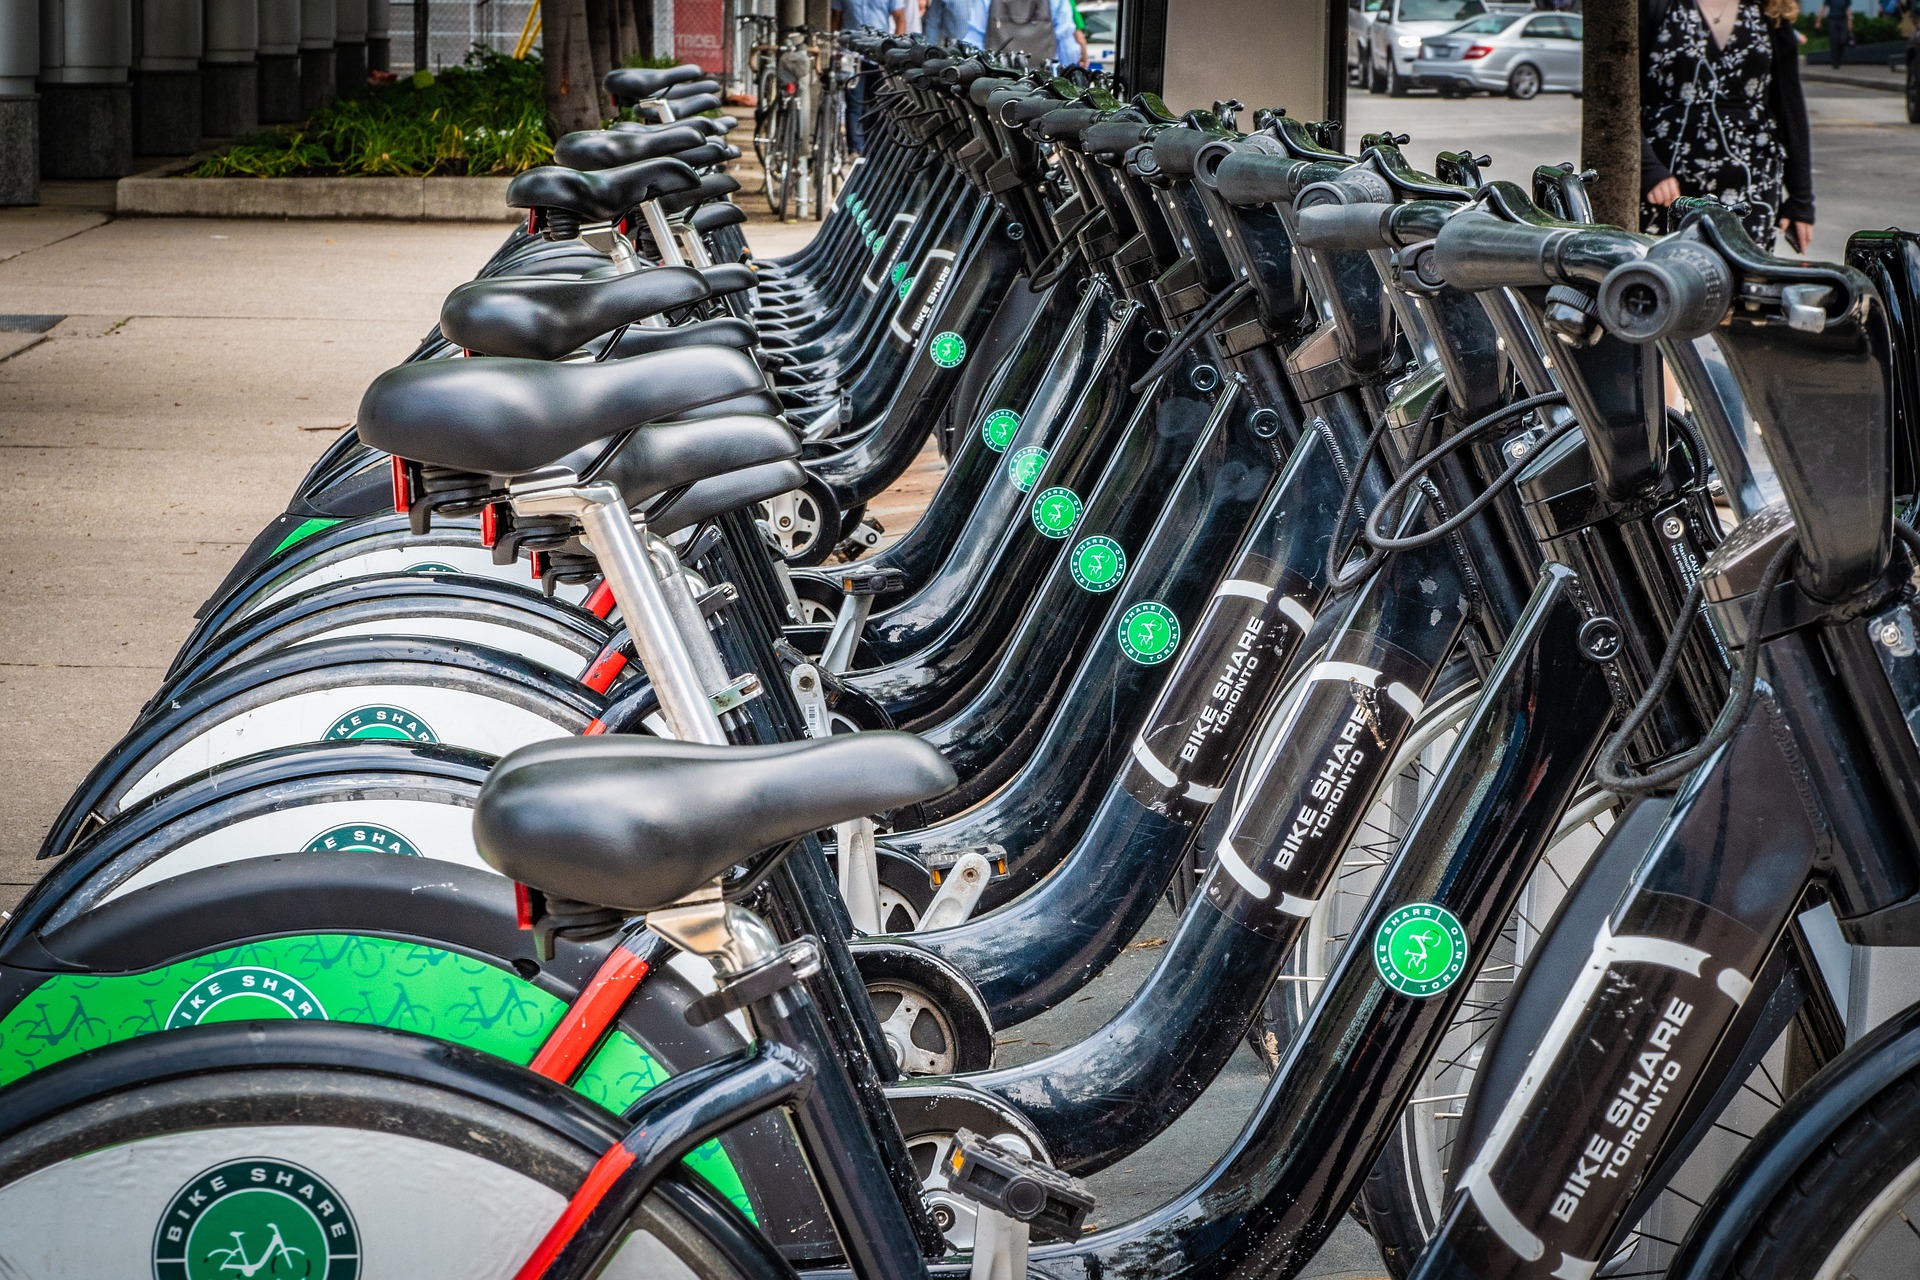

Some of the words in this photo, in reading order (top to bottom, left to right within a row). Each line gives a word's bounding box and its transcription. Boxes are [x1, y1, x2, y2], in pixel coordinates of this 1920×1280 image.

[911, 304, 930, 332] BIKE
[926, 265, 951, 305] SHARE
[1038, 490, 1063, 505] SHARE
[1035, 510, 1044, 530] BIKE
[1075, 538, 1104, 555] SHARE
[1688, 554, 1702, 576] CAUT
[1073, 561, 1085, 583] BIKE
[1098, 549, 1123, 589] TORONTO
[1124, 605, 1156, 624] SHARE
[1121, 630, 1135, 655] BIKE
[1149, 617, 1178, 661] TORONTO
[1180, 705, 1218, 763] BIKE
[1212, 616, 1265, 701] SHARE
[1212, 656, 1259, 735] TORONTO
[376, 711, 430, 742] SHAR
[1273, 804, 1318, 871] BIKE
[1311, 704, 1369, 801] SHARE
[1310, 750, 1365, 838] TORONTO
[354, 830, 412, 856] SHA
[1384, 908, 1431, 935] SHARE
[1379, 945, 1397, 981] BIKE
[1420, 926, 1463, 992] TORONTO
[174, 982, 222, 1028] IKE
[242, 975, 313, 1017] SHAR
[1549, 1133, 1614, 1223] BIKE
[1605, 996, 1694, 1128] SHARE
[1601, 1060, 1682, 1179] TORONTO
[166, 1175, 227, 1243] BIKE
[250, 1168, 347, 1239] SHARE
